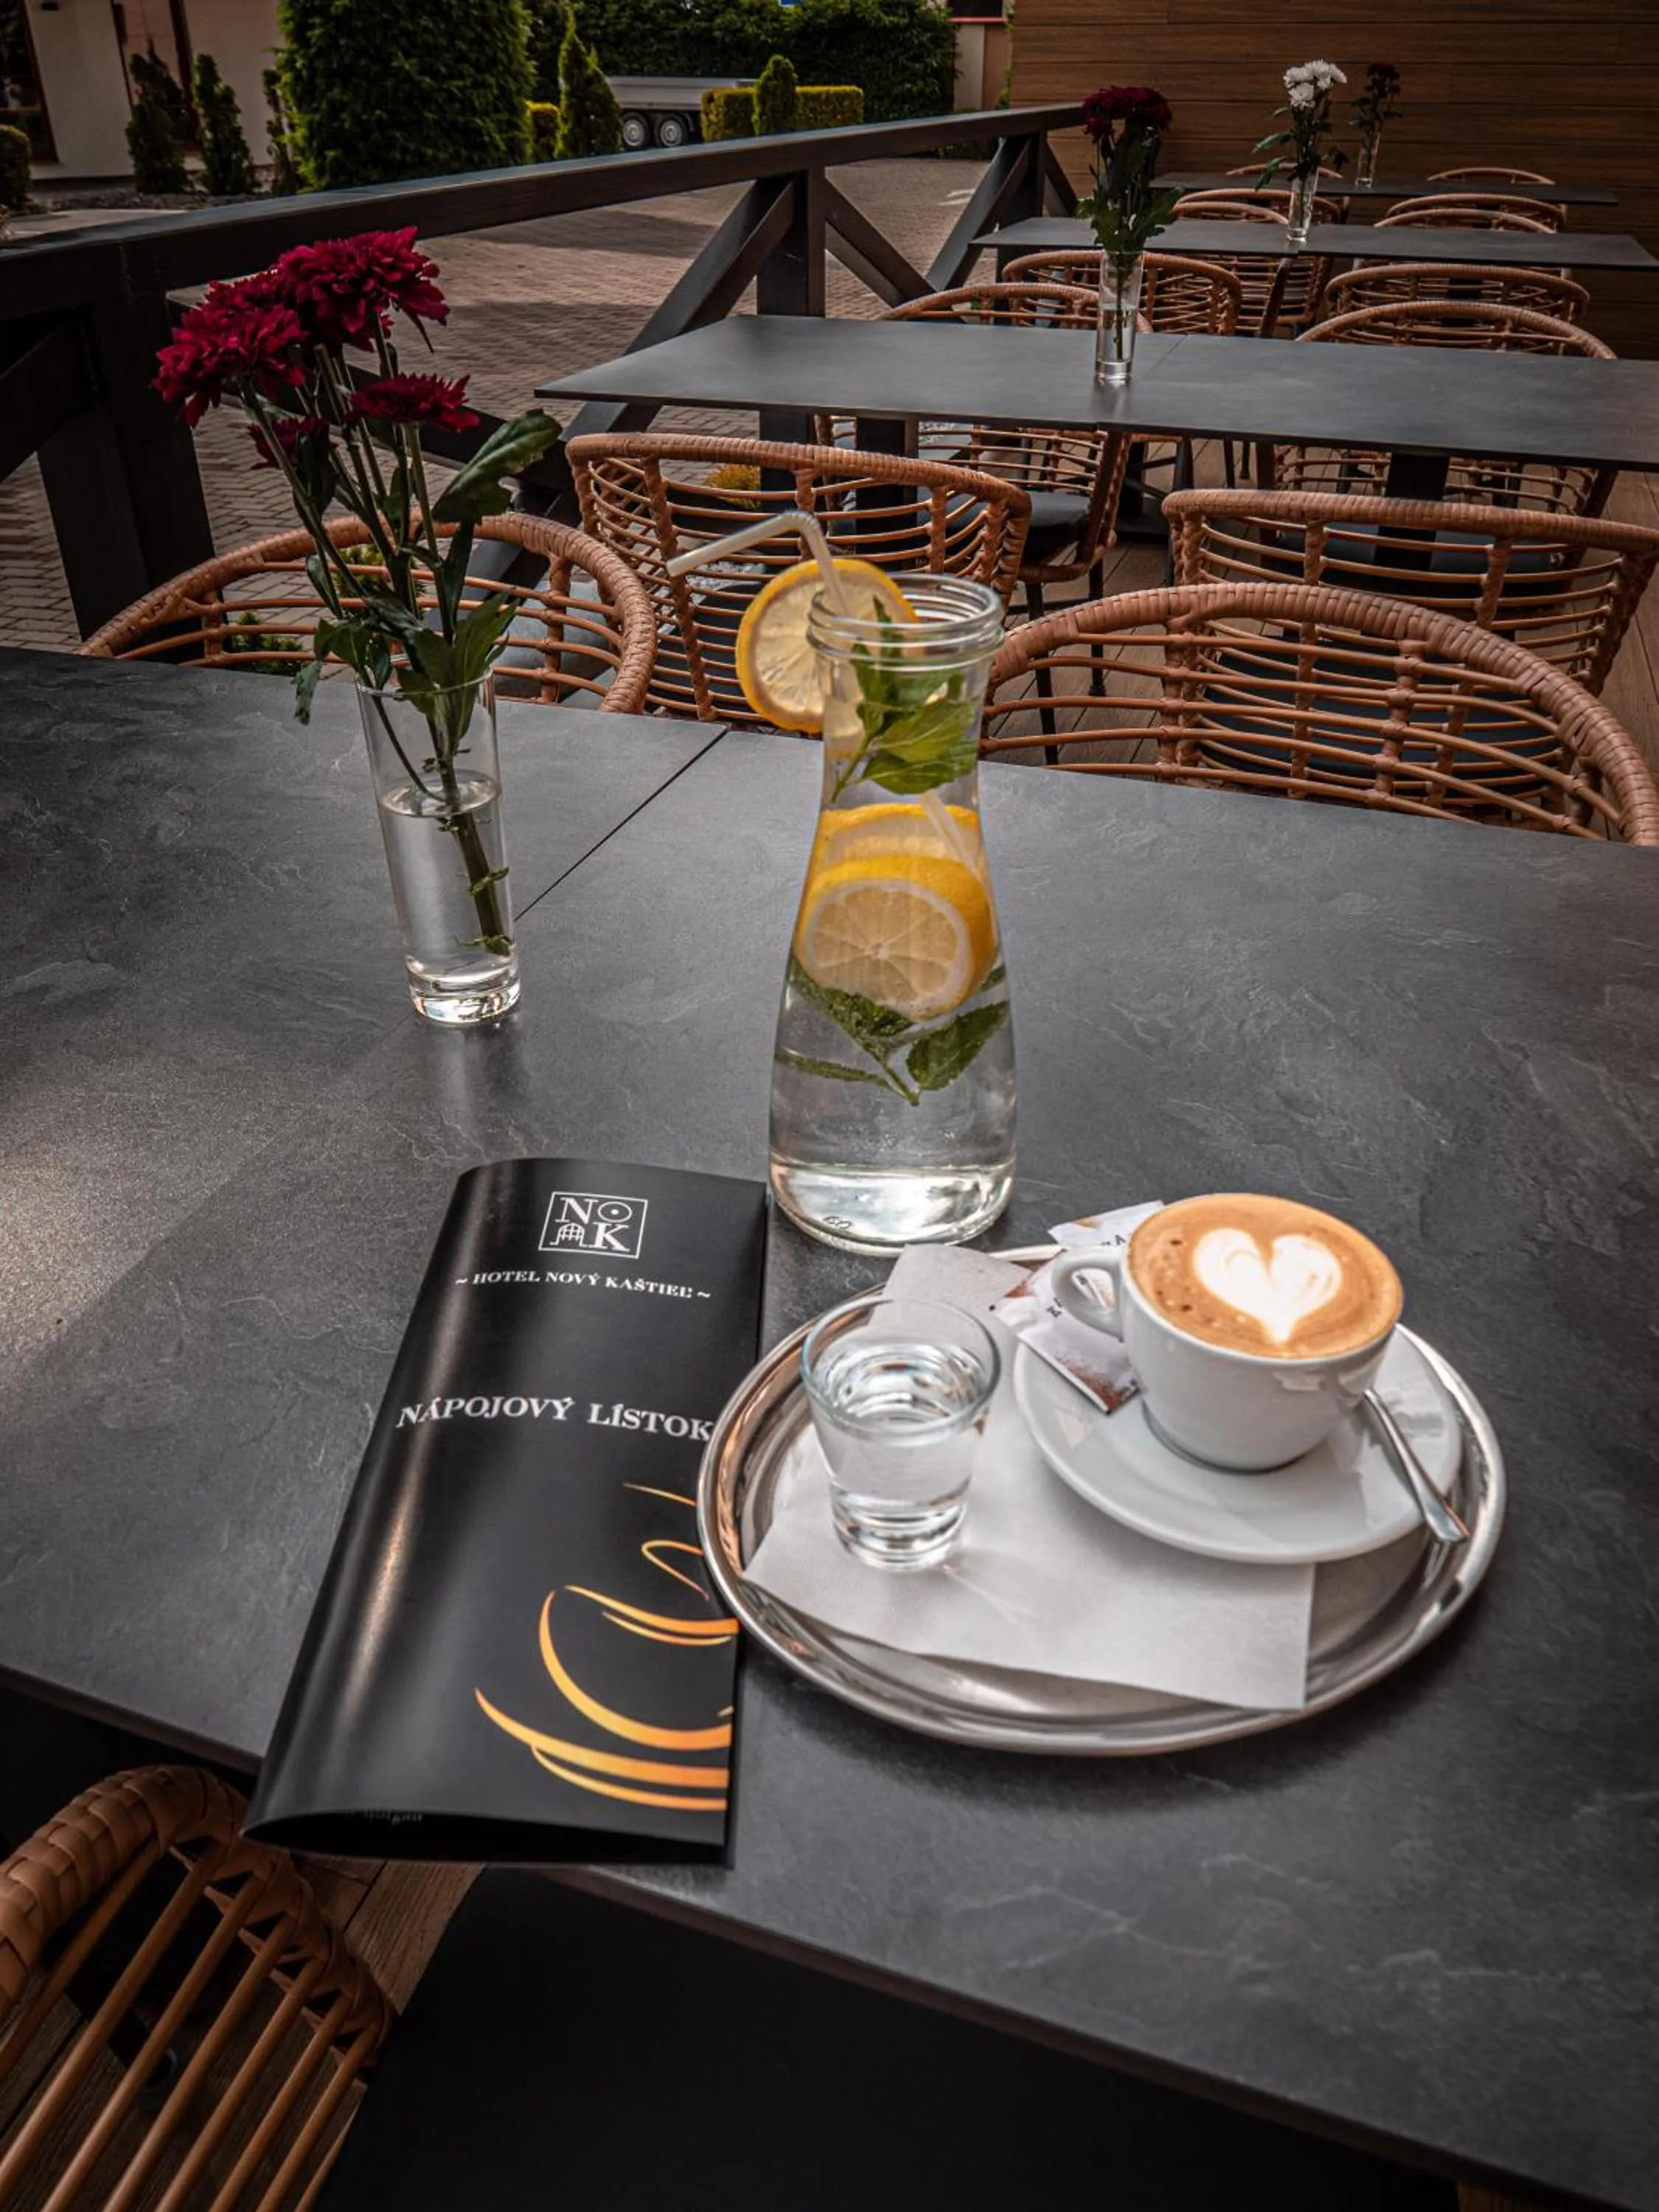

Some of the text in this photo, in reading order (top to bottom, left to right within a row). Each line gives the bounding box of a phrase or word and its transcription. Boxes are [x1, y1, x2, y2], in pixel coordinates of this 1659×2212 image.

[472, 1270, 540, 1285] HOTEL
[545, 1271, 601, 1287] NOVÝ
[395, 1396, 714, 1441] NÁPOJOVÝ LÍSTOK
